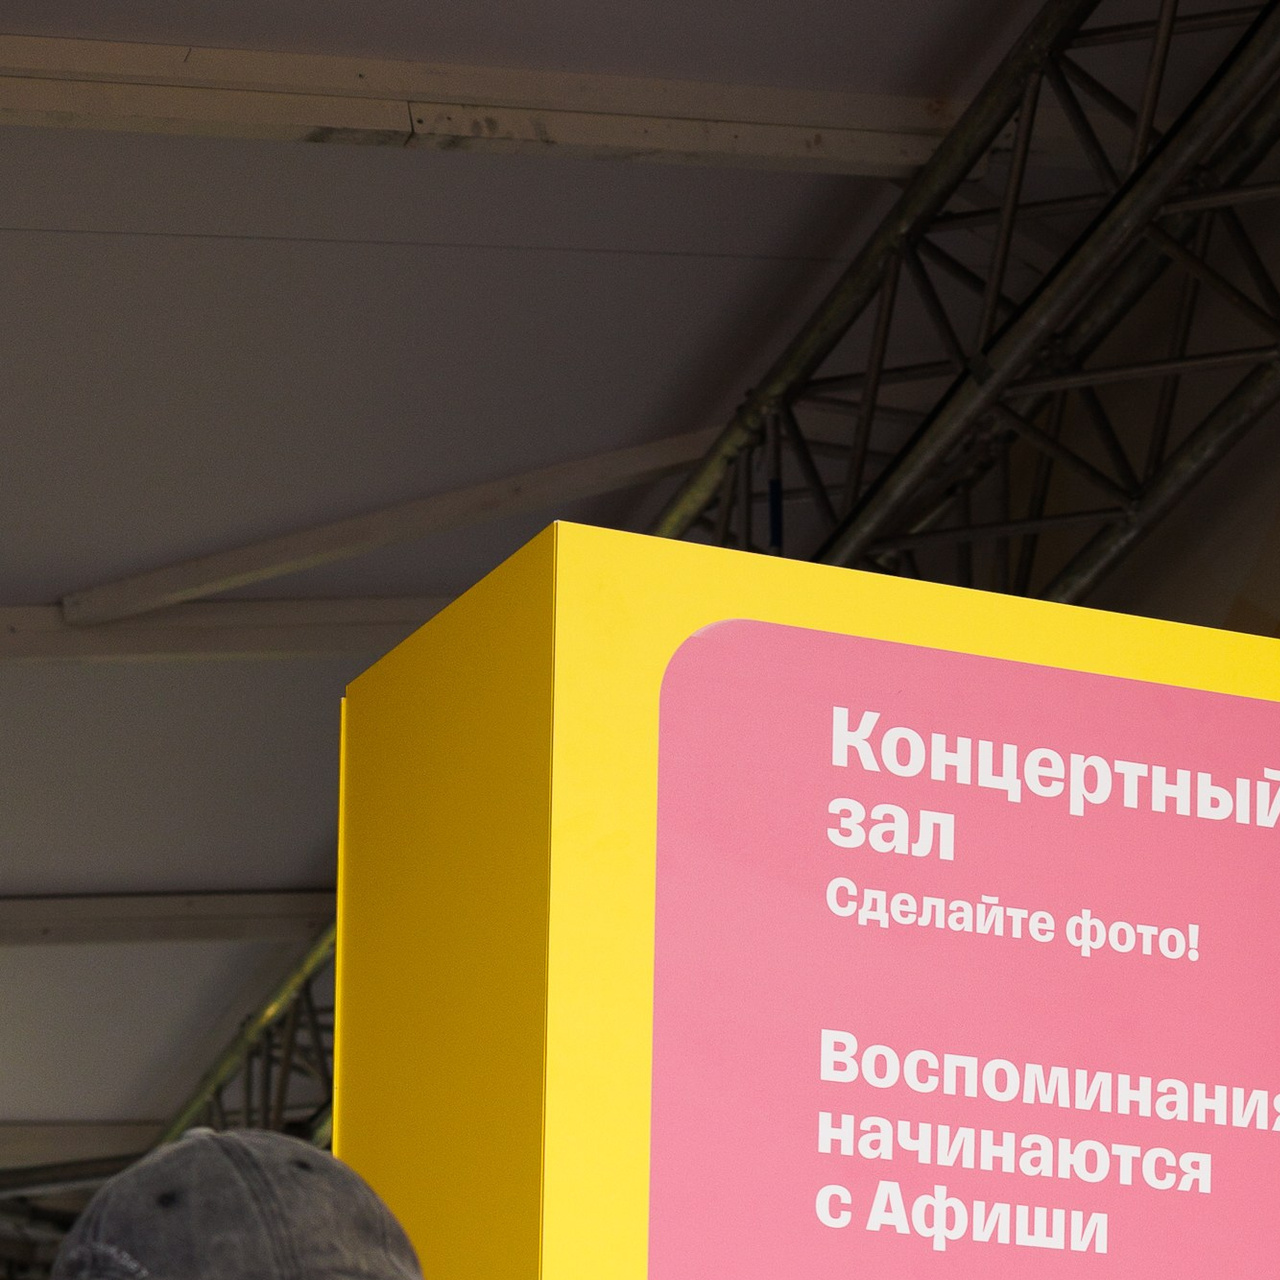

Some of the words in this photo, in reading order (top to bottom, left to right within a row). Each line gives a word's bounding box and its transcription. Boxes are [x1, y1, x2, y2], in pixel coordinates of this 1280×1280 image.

[826, 797, 956, 861] зал
[826, 876, 1056, 943] Сделайте
[1065, 908, 1200, 962] фото!
[817, 1111, 1213, 1195] начинаются
[815, 1184, 853, 1229] с
[865, 1180, 1109, 1254] Афиши
